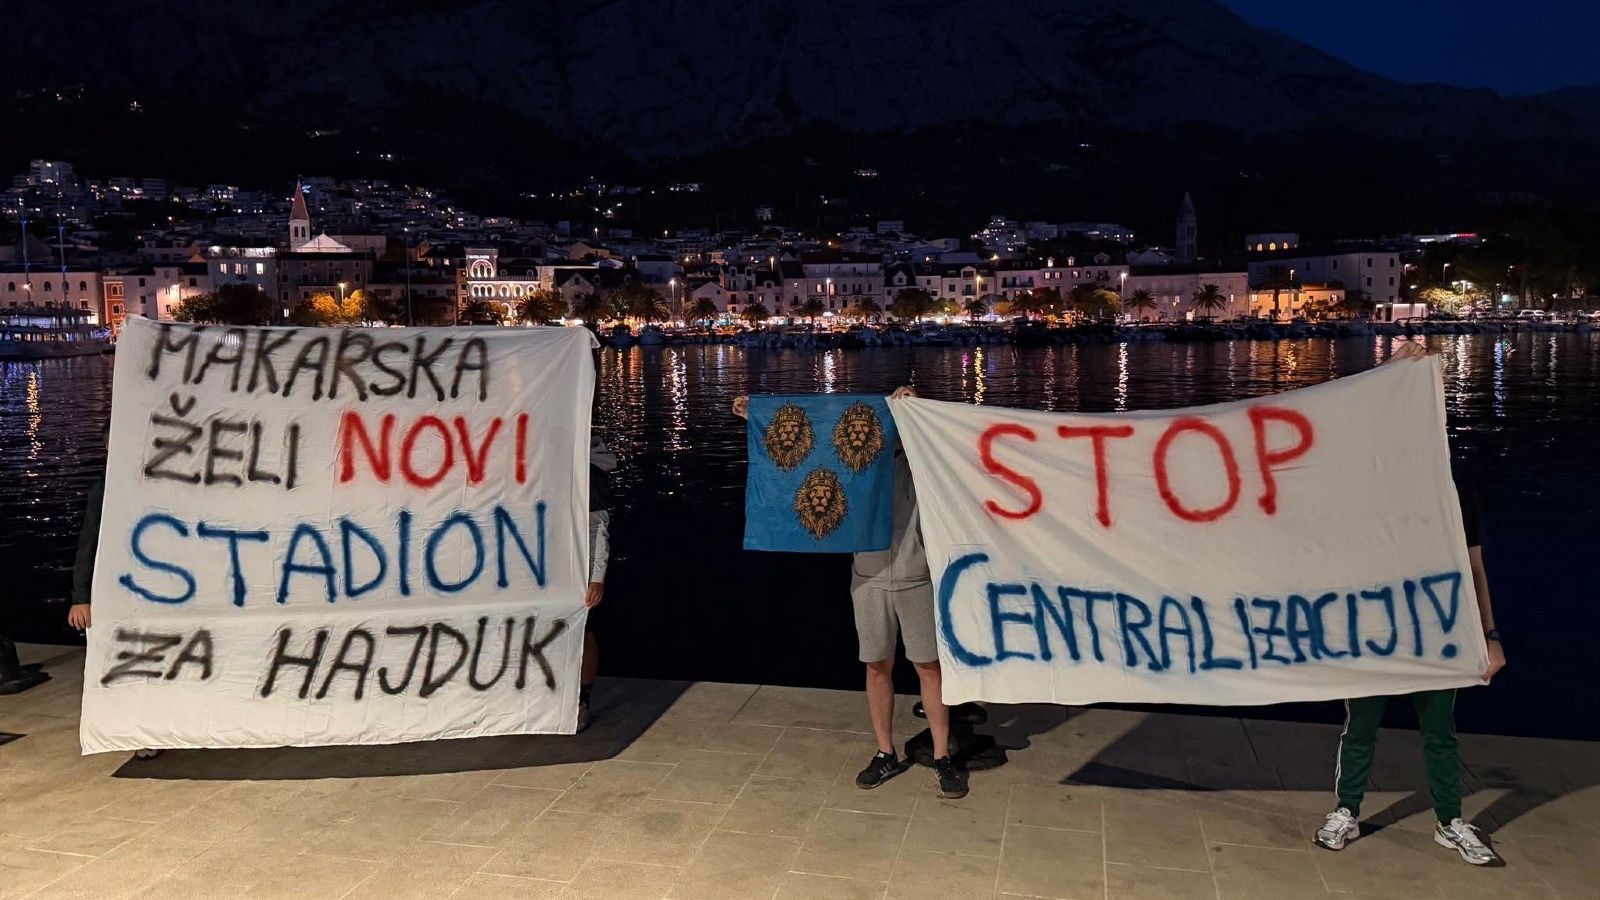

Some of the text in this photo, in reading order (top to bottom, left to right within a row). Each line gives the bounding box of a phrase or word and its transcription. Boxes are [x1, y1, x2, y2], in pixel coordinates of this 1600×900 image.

[148, 323, 489, 402] MAKARSKA
[144, 393, 530, 489] ŽELI NOVI
[977, 406, 1314, 528] STOP
[119, 501, 547, 607] STADION
[100, 616, 569, 700] ZA HAJDUK
[938, 551, 1463, 673] CENTRALIZACIJI!
